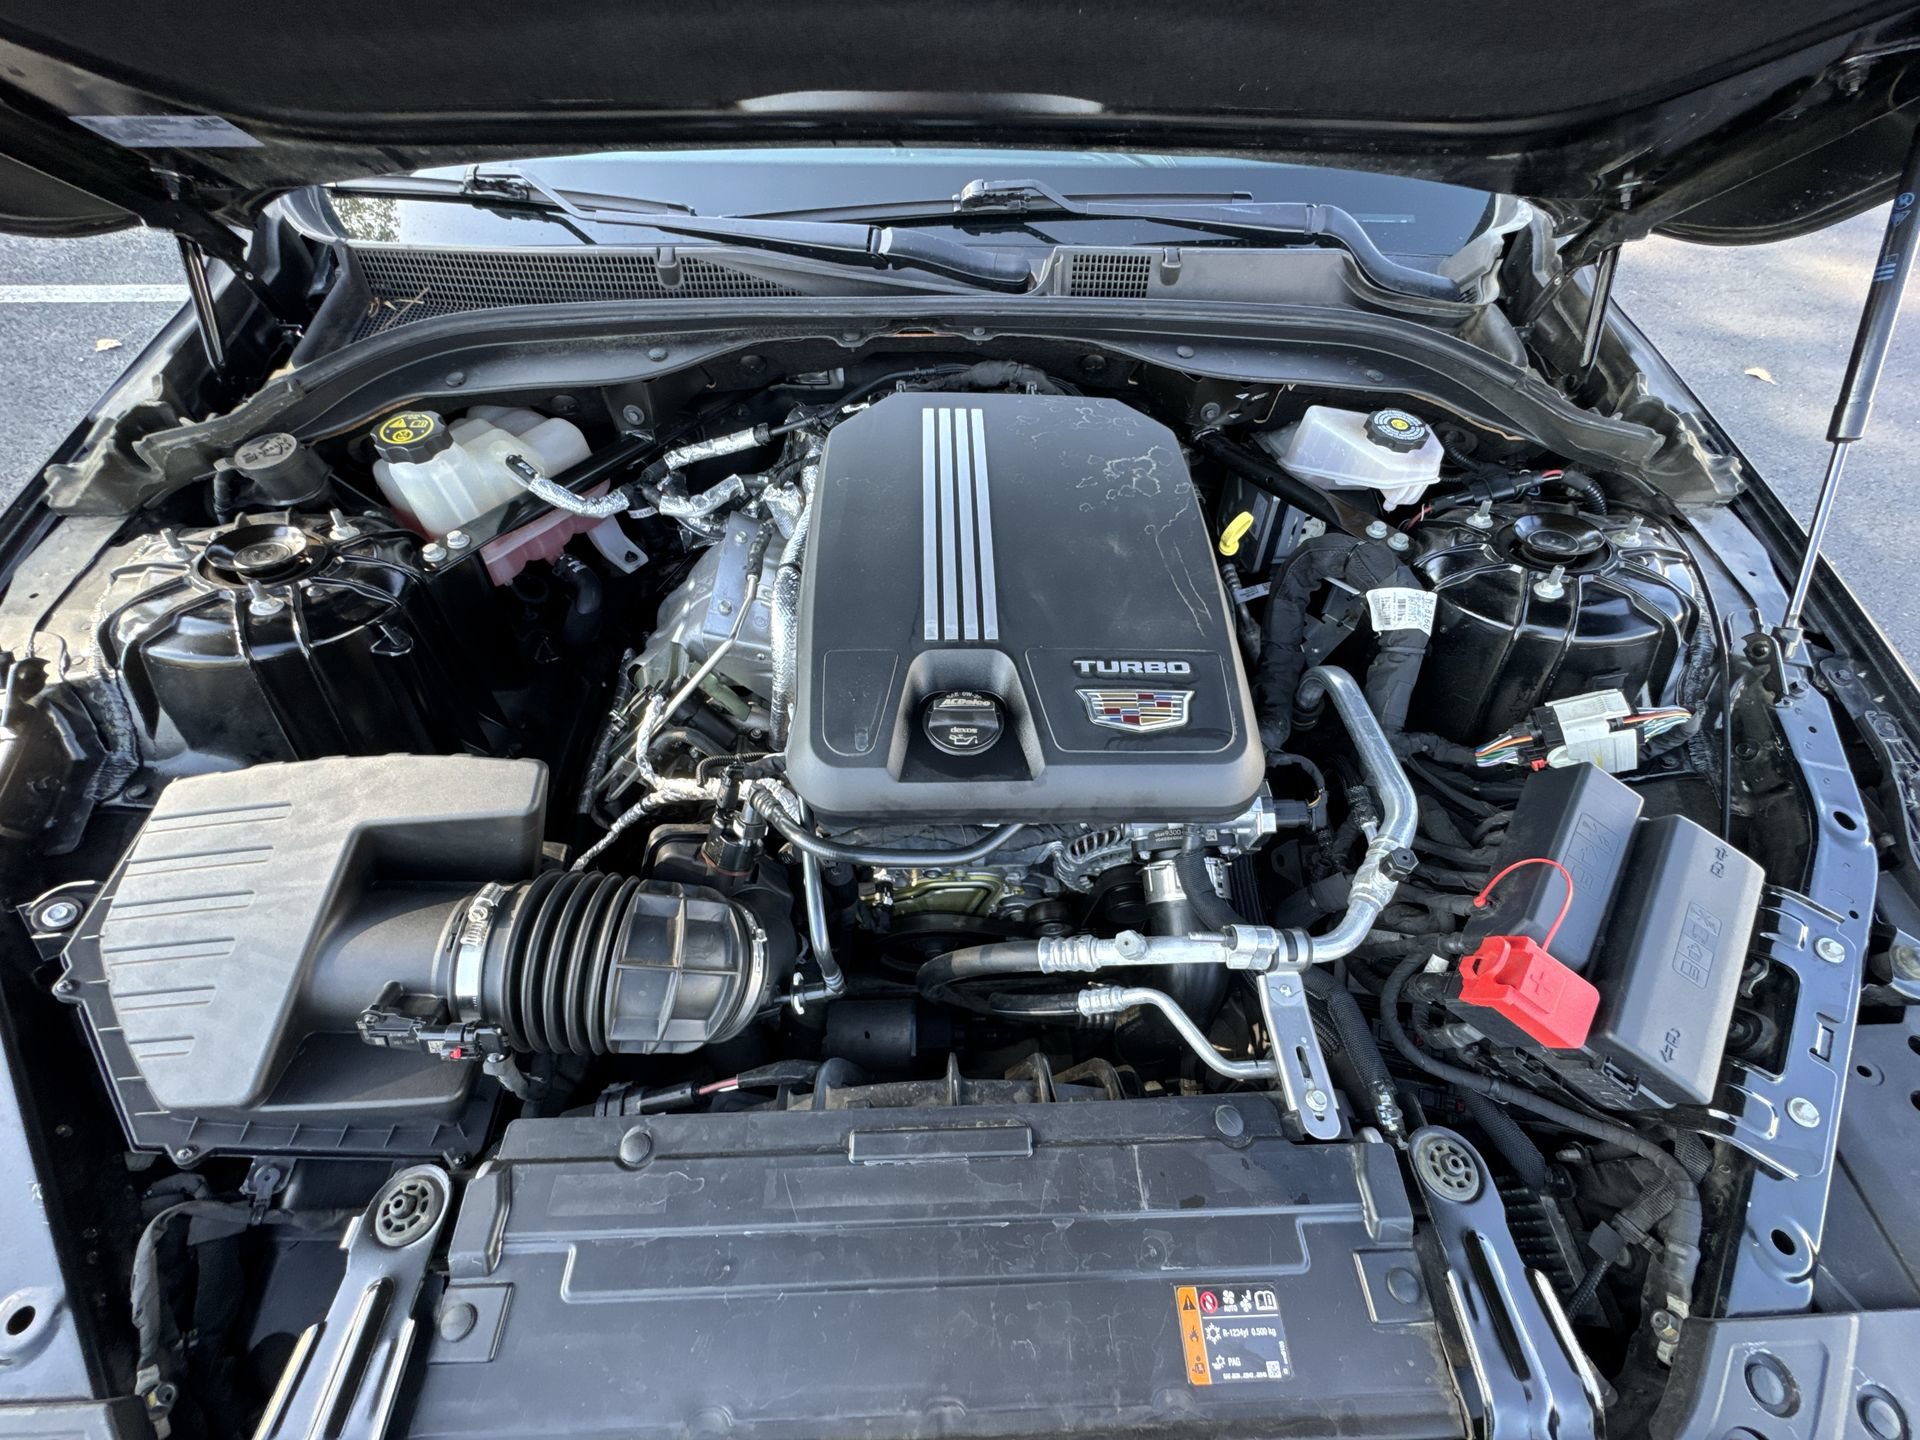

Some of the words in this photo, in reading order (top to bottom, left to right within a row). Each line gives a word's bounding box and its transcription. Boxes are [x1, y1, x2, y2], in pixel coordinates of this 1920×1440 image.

[1073, 660, 1190, 673] TURBO
[939, 698, 991, 707] ACDelco
[1251, 1327, 1267, 1337] 0.500
[1267, 1326, 1277, 1338] kg
[1228, 1357, 1241, 1367] PAG
